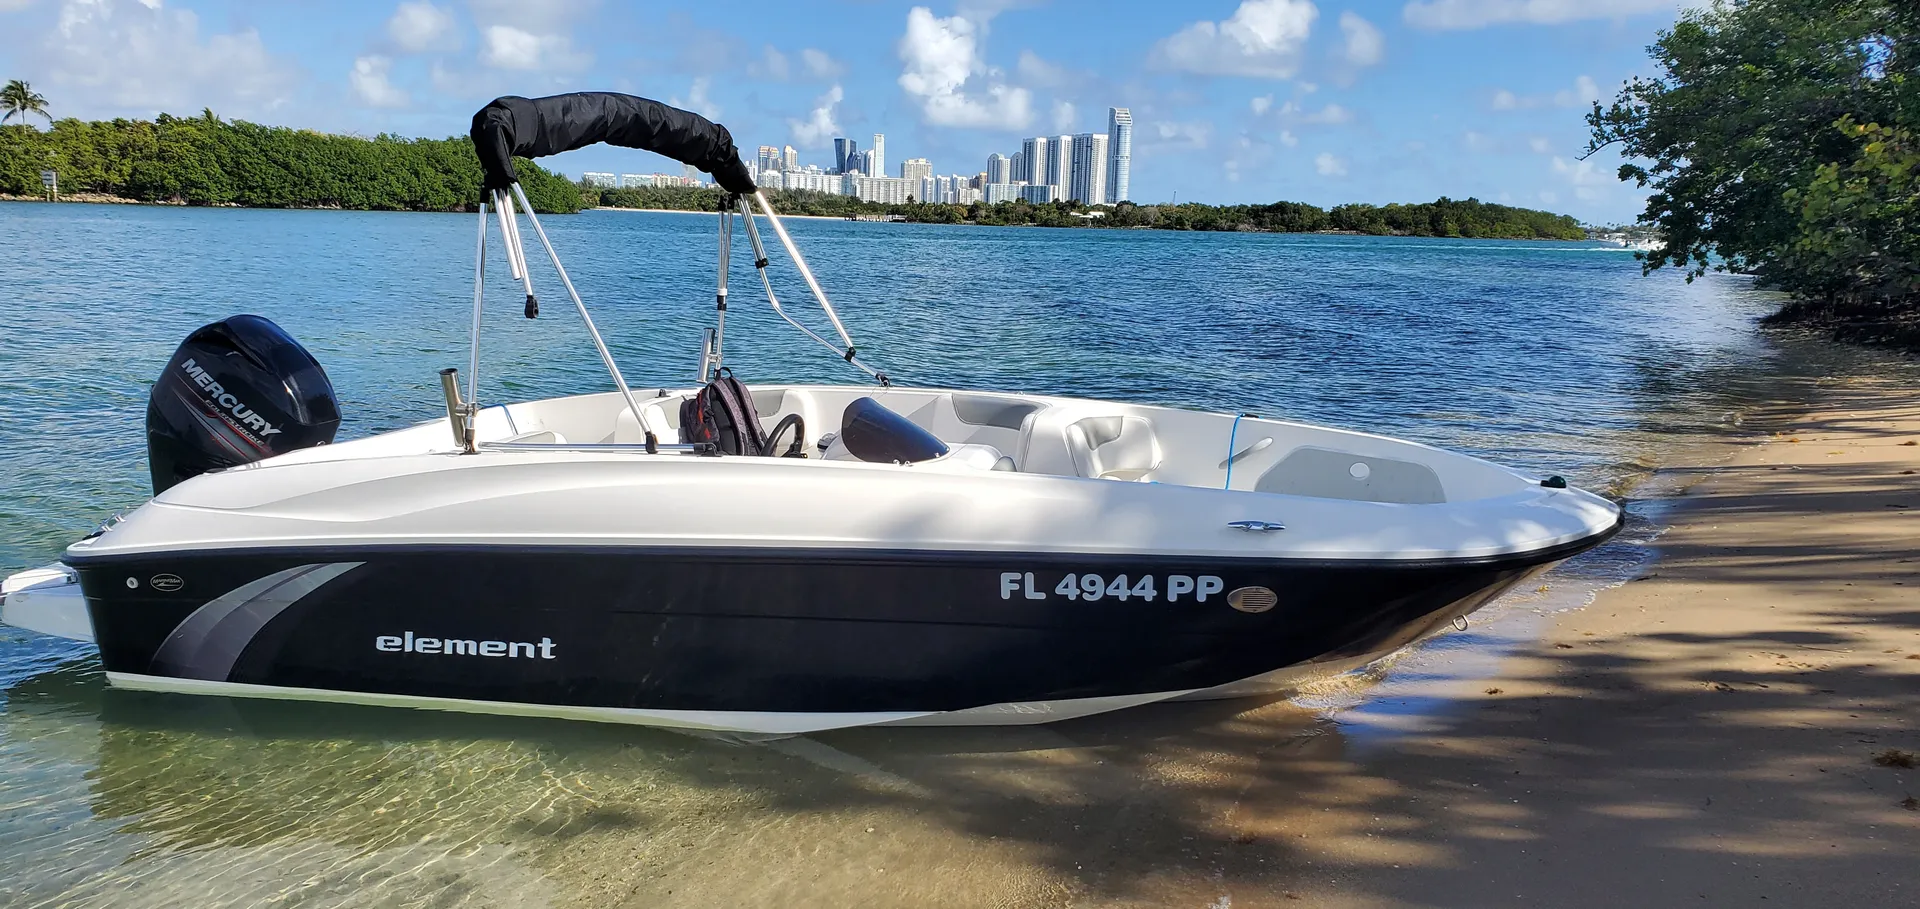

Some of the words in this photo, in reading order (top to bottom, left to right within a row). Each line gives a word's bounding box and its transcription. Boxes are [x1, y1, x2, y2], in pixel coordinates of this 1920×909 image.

[181, 358, 282, 437] MERCURY
[1000, 572, 1047, 600] FL
[1054, 573, 1158, 601] 4944
[1167, 574, 1224, 603] PP
[375, 631, 557, 660] element
